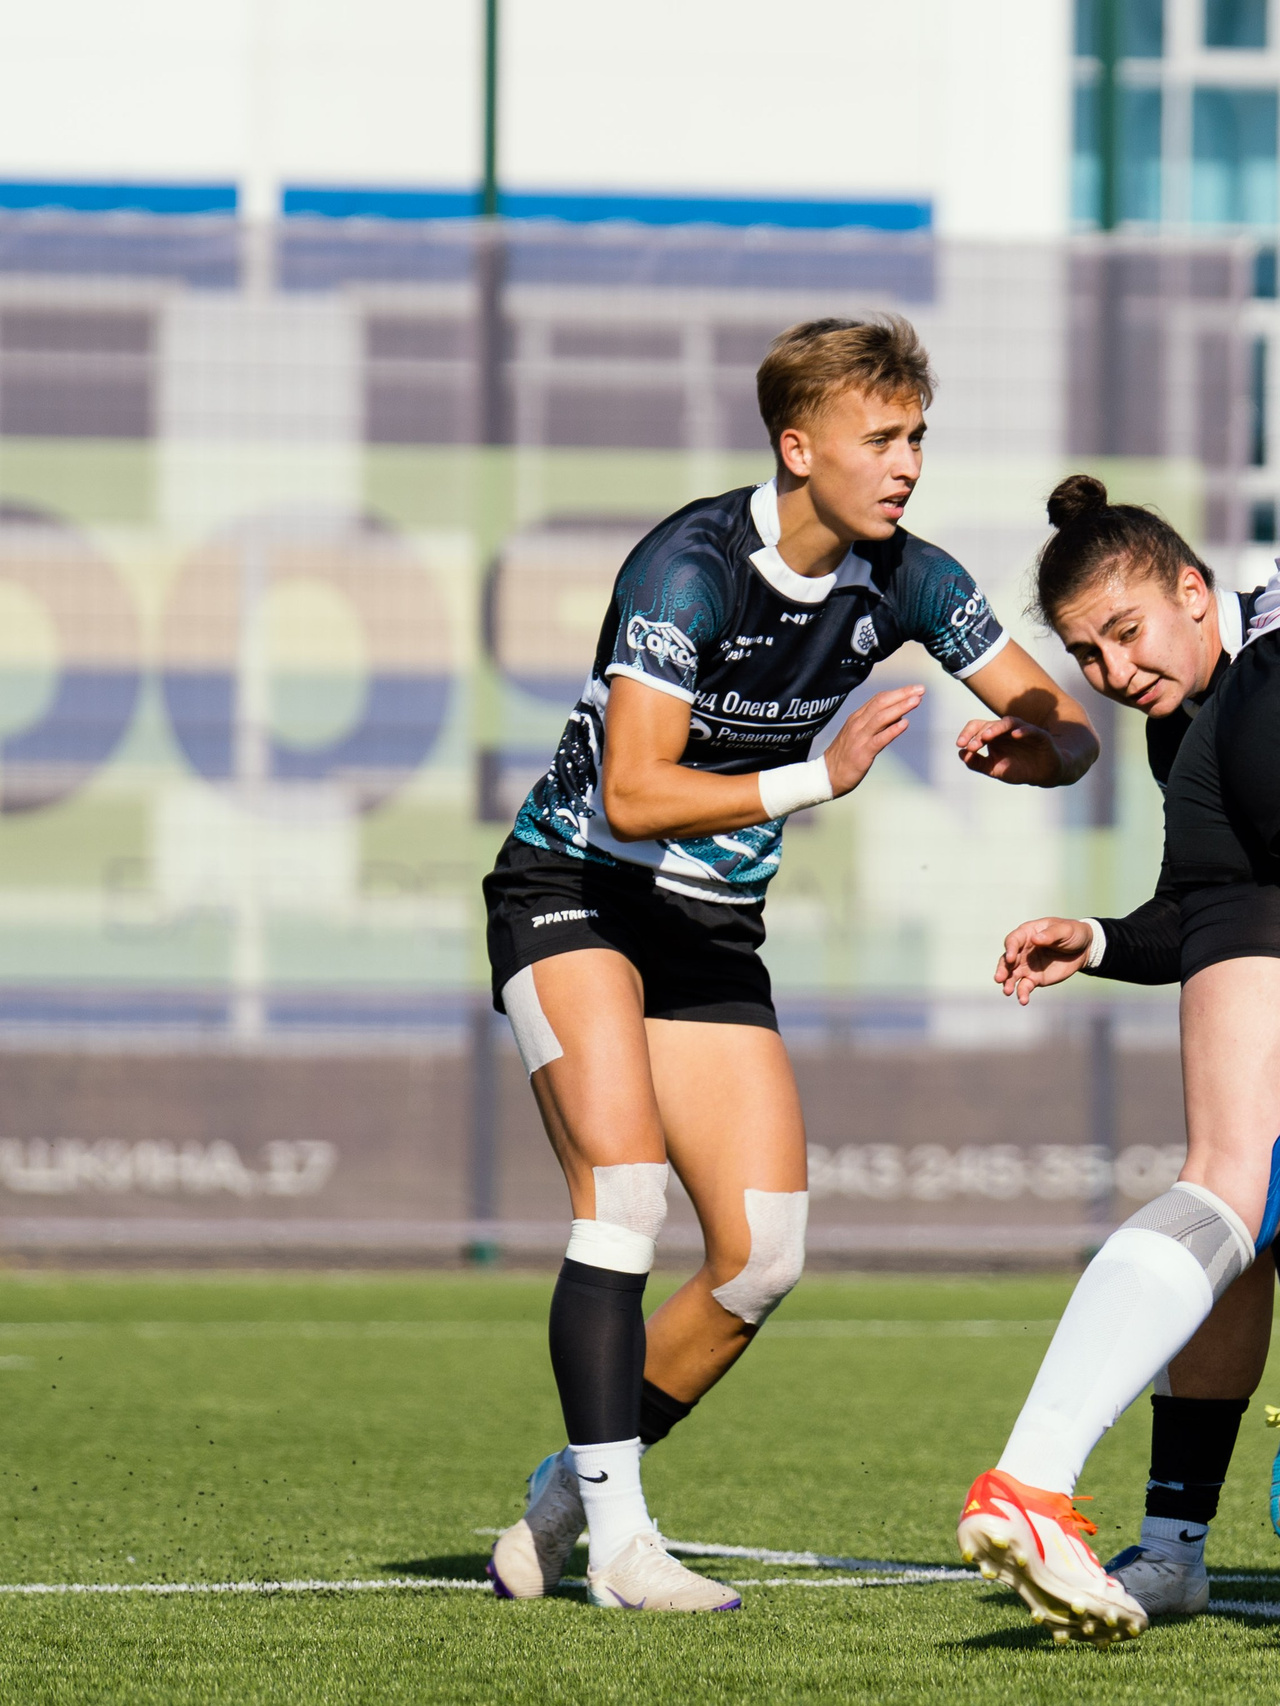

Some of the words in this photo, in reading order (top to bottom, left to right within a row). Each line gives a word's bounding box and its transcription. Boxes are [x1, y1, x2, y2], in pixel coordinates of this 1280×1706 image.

[722, 691, 780, 719] Олега
[716, 726, 791, 744] Развитие
[545, 908, 599, 925] PATRICK
